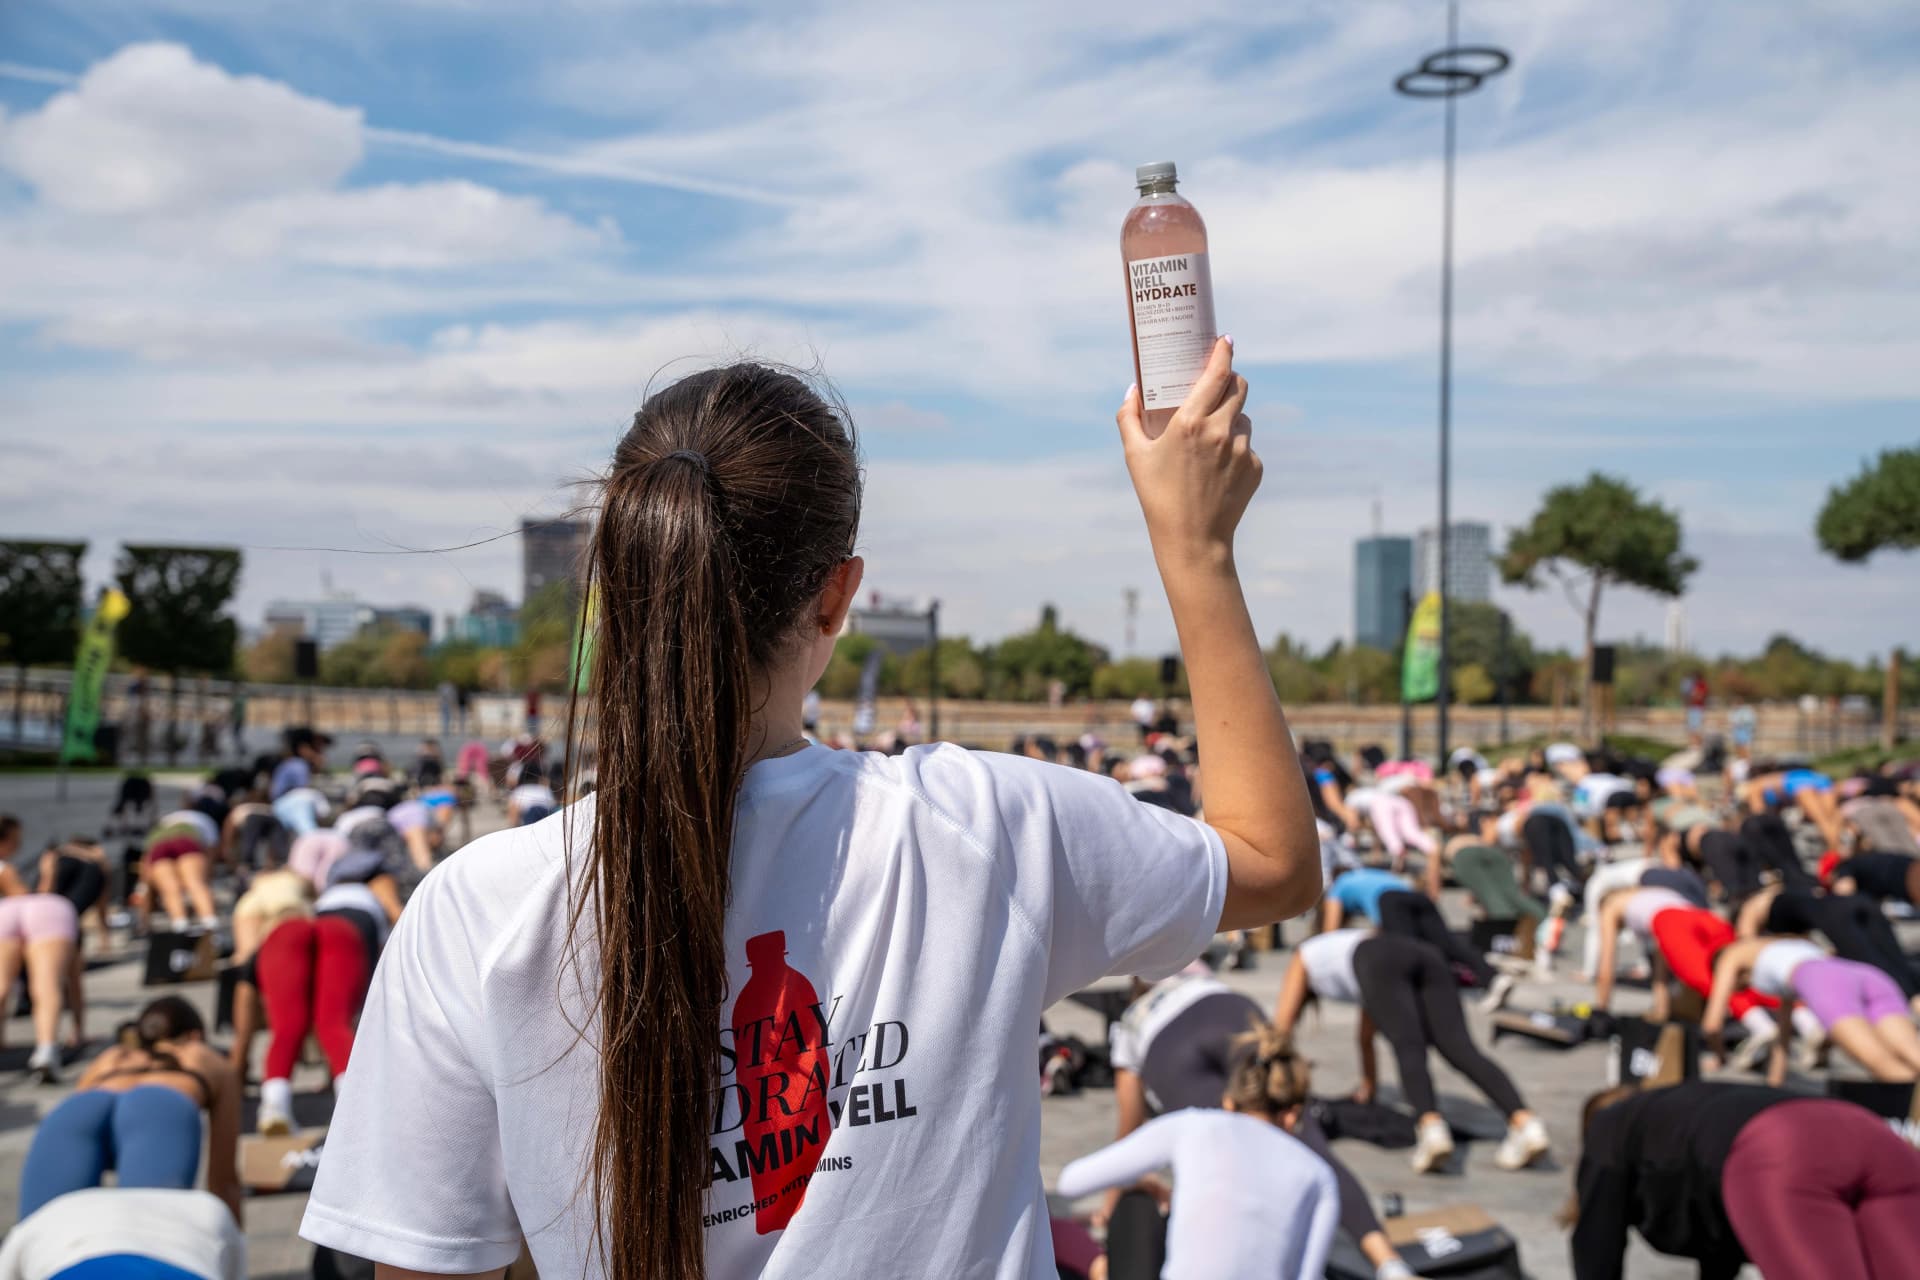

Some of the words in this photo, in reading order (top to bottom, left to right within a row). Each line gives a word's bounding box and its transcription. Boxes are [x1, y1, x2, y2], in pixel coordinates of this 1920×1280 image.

[1131, 258, 1188, 277] VITAMIN
[1133, 274, 1166, 289] WELL
[1135, 283, 1197, 303] HYDRATE
[720, 995, 844, 1076] STAY
[711, 1113, 820, 1183] AMIN
[703, 1193, 779, 1228] ENRICHED
[815, 1156, 853, 1173] MINS
